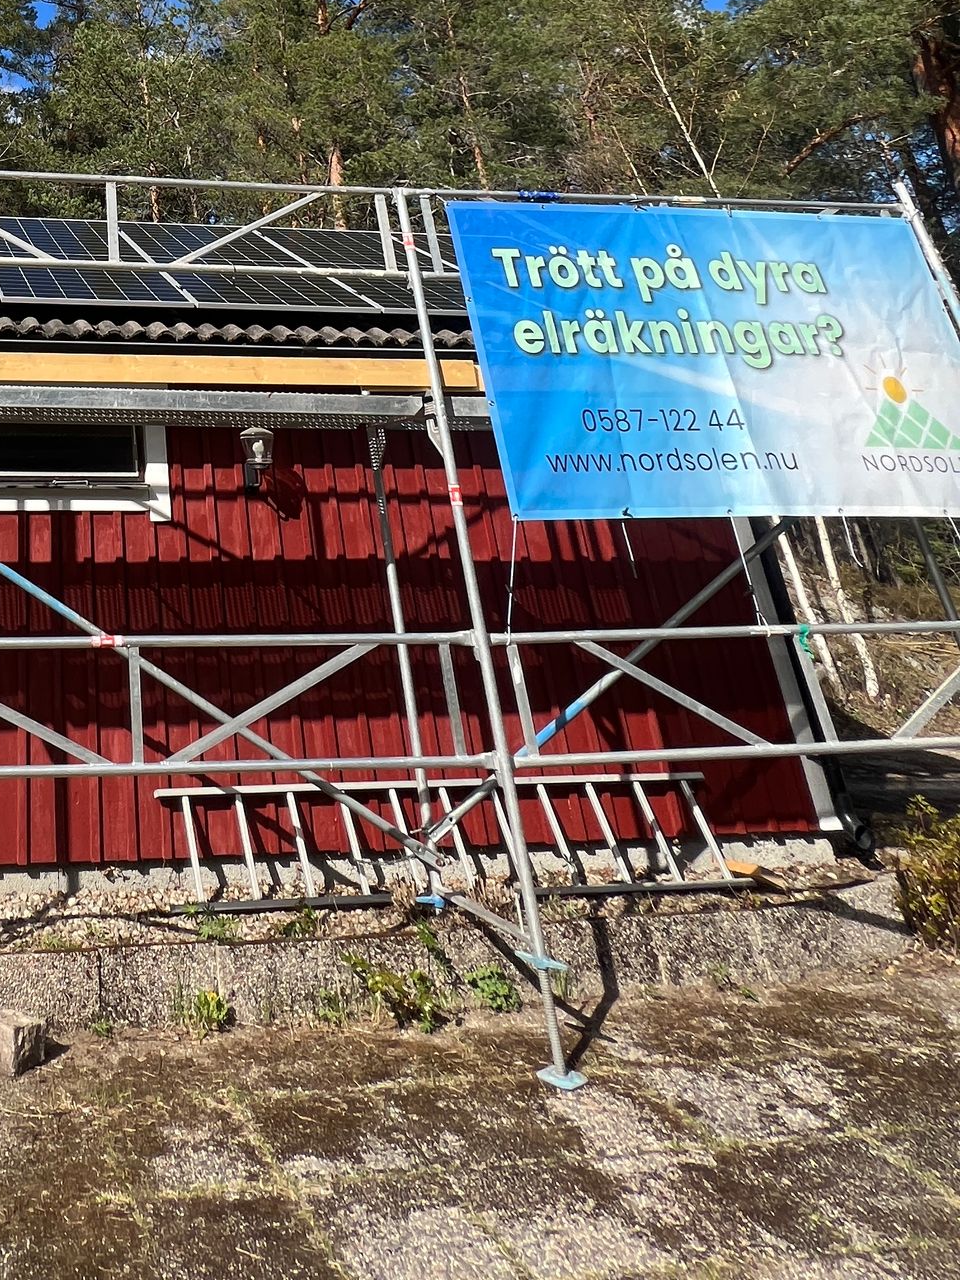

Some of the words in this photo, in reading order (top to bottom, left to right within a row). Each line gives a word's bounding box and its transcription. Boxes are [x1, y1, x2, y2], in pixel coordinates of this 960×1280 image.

[491, 245, 624, 289] Trött
[630, 243, 702, 303] på
[708, 251, 828, 306] dyra
[513, 308, 844, 370] elräkningar?
[581, 408, 701, 433] 0587-122
[708, 408, 745, 433] 44
[545, 446, 800, 474] www.nordsolen.nu
[861, 454, 960, 473] NORDSOL
